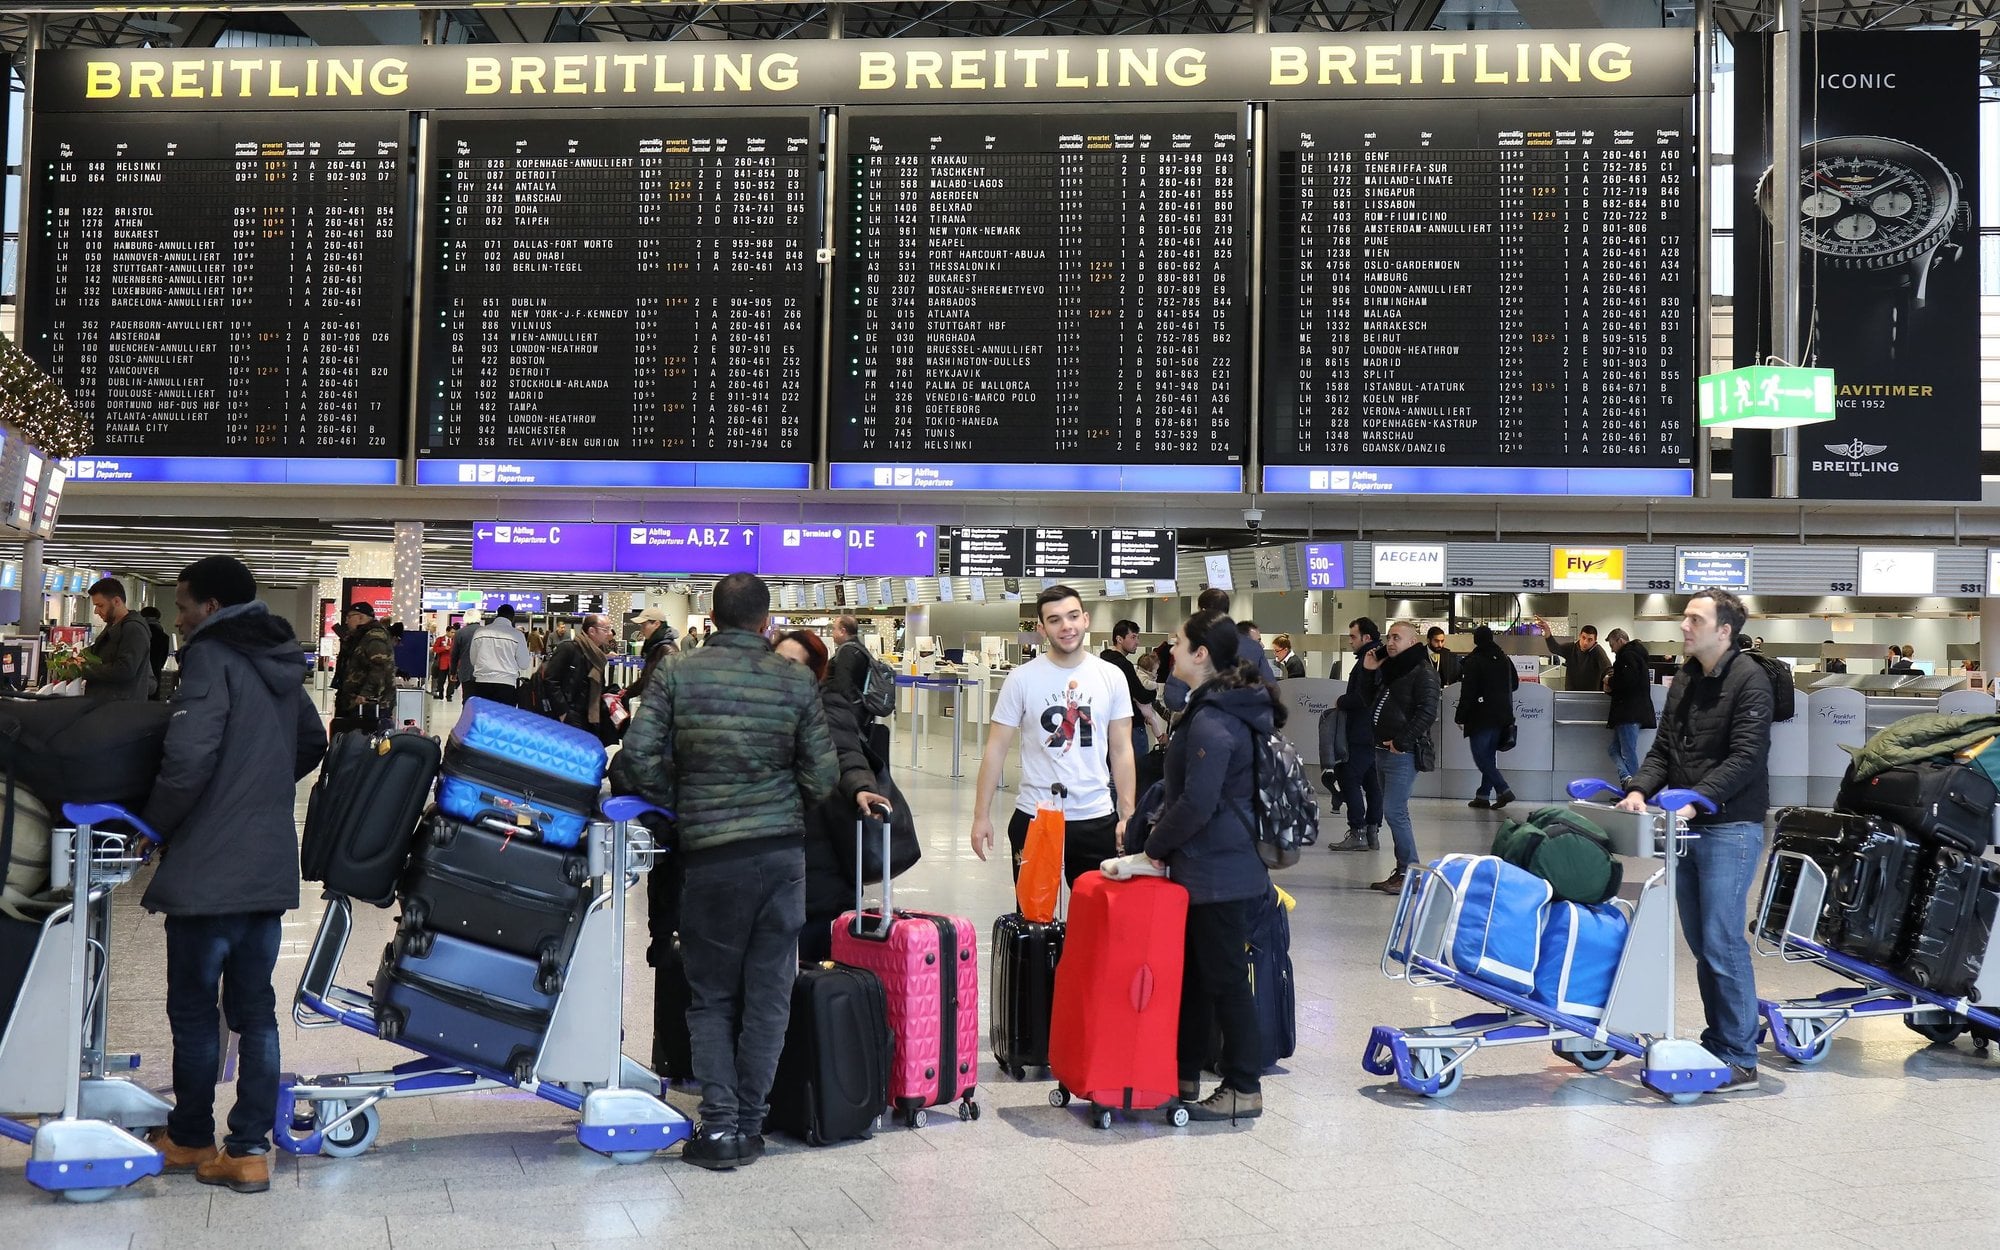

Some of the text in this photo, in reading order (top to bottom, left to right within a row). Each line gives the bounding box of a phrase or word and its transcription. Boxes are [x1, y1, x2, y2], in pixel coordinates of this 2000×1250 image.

[859, 46, 1206, 89] BREITLING
[1269, 41, 1632, 85] BREITLING
[86, 57, 408, 98] BREITLING
[466, 53, 799, 94] BREITLING
[1821, 74, 1895, 88] ICONIC
[931, 155, 968, 165] KRAKAU
[1364, 151, 1390, 162] GENF
[116, 161, 161, 171] HELSINKI
[516, 158, 633, 169] KOPENHAGE-ANNULLIERT
[1365, 163, 1448, 173] TENERIFFA-SUR
[515, 170, 557, 180] DETROIT
[930, 167, 986, 177] TASCHKENT
[116, 173, 162, 183] CHISINAU
[1364, 175, 1453, 185] MAILAND-LINATE
[515, 182, 557, 191] ANTALYA
[930, 178, 1004, 189] MALABO-LAGOS
[929, 190, 979, 200] ABERDEEN
[1364, 187, 1415, 198] SINGAPUR
[514, 193, 562, 203] WARSCHAU
[514, 205, 538, 214] DOHA
[1364, 199, 1416, 210] LISSABON
[114, 207, 154, 216] BRISTOL
[1364, 211, 1447, 222] ROM-FIUMICINO
[114, 218, 143, 228] ATHEN
[514, 216, 549, 226] TAIPEH
[930, 214, 966, 224] TIRANA
[929, 226, 1021, 236] NEW YORK-NEWARK
[1364, 223, 1492, 234] AMSTERDAM-ANNULLIERT
[114, 229, 159, 239] BUKAREST
[113, 241, 216, 250] HAMBURG-ANNULLIERT
[513, 239, 578, 249] DALLAS-FORT
[928, 238, 965, 248] NEAPEL
[1364, 236, 1389, 246] PUNE
[113, 252, 221, 262] HANNOVER-ANNULLIERT
[513, 251, 564, 261] ABU DHABI
[928, 249, 1046, 260] PORT HARCOURT-ABUJA
[1364, 248, 1390, 258] WIEN
[112, 263, 226, 273] STUTTGART-ANNULLIERT
[513, 262, 583, 272] BERLIN-TEGEL
[929, 261, 1001, 271] THESSALONIKI
[1364, 260, 1460, 270] OSLO-GARDERMOEN
[112, 275, 226, 284] NUERNBERG-ANNULLIERT
[928, 273, 977, 283] BUKAREST
[1364, 272, 1408, 282] HAMBURG
[112, 286, 225, 296] LUXEMBURG-ANNULLIERT
[928, 285, 1045, 295] MOSKAU-SHEREMETYEVO
[1364, 284, 1472, 294] LONDON-ANNULLIERT
[111, 297, 225, 307] BARCELONA-ANNULLIERT
[511, 297, 547, 307] DUBLIN
[928, 297, 977, 307] BARBADOS
[1363, 296, 1427, 306] BIRMINGHAM
[511, 309, 529, 319] NEW
[927, 309, 970, 319] ATLANTA
[1363, 309, 1402, 319] MALAGA
[511, 321, 552, 330] VILNIUS
[927, 321, 1006, 331] STUTTGART HBF
[1363, 321, 1427, 331] MARRAKESCH
[109, 332, 161, 341] AMSTERDAM
[510, 332, 598, 342] WIEN-ANNULLIERT
[926, 333, 976, 342] HURGHADA
[1363, 333, 1401, 343] BEIRUT
[109, 343, 217, 353] MUENCHEN-ANNULLIERT
[510, 344, 598, 354] LONDON-HEATHROW
[926, 344, 1043, 354] BRUESSEL-ANNULLIERT
[1363, 345, 1460, 355] LONDON-HEATHROW
[108, 354, 194, 364] OSLO-ANNULLIERT
[509, 355, 545, 365] BOSTON
[1363, 357, 1401, 367] MADRID
[108, 366, 160, 375] VANCOUVER
[509, 367, 550, 377] DETROIT
[926, 368, 981, 378] REYKJAVIK
[1363, 369, 1395, 379] SPLIT
[107, 377, 205, 387] DUBLIN-ANNULLIERT
[509, 379, 609, 389] STOCKHOLM-ARLANDA
[925, 380, 1030, 390] PALMA DE MALLORCA
[1364, 382, 1465, 392] ISTANBUL-ATATURK
[108, 388, 216, 399] TOULOUSE-ANNULLIERT
[508, 390, 544, 400] MADRID
[925, 392, 1036, 402] VENEDIG-MARCO POLO
[1362, 394, 1420, 404] KOELN HBF
[1862, 400, 1884, 408] 1952
[508, 402, 538, 412] TAMPA
[925, 404, 980, 414] GOETEBORG
[1362, 406, 1472, 416] VERONA-ANNULLIERT
[106, 411, 209, 421] ATLANTA-ANNULLIERT
[508, 414, 597, 424] LONDON-HEATHROW
[925, 416, 999, 426] TOKIO-HANEDA
[106, 423, 169, 432] PANAMA CITY
[1362, 418, 1478, 429] KOPENHAGEN-KASTRUP
[507, 425, 566, 435] MANCHESTER
[924, 428, 955, 438] TUNIS
[105, 434, 145, 444] SEATTLE
[1362, 430, 1414, 441] WARSCHAU
[507, 437, 619, 447] TEL AVIV-BEN GURION
[924, 440, 972, 450] HELSINKI
[1362, 442, 1446, 453] GDANSK/DANZIG
[96, 461, 119, 471] Abflug
[497, 464, 521, 474] Abflug
[1813, 461, 1898, 472] BREITLING
[96, 470, 133, 479] Departures
[915, 468, 939, 478] Abflug
[1352, 471, 1377, 482] Abflug
[497, 474, 536, 483] Departures
[914, 478, 953, 487] Departures
[1351, 481, 1392, 491] Departures
[513, 526, 561, 544] Abflug C
[649, 528, 671, 537] Abflug
[802, 529, 831, 538] Terminal
[513, 536, 547, 544] Departures
[649, 537, 684, 546] Departures
[1380, 552, 1438, 562] AEGEAN
[1568, 557, 1592, 572] Fly
[1311, 573, 1330, 585] 570
[1452, 578, 1473, 586] 535
[1523, 579, 1544, 588] 534
[1648, 581, 1670, 589] 533
[1831, 583, 1852, 591] 532
[1961, 584, 1981, 592] 531
[1040, 706, 1092, 748] 91
